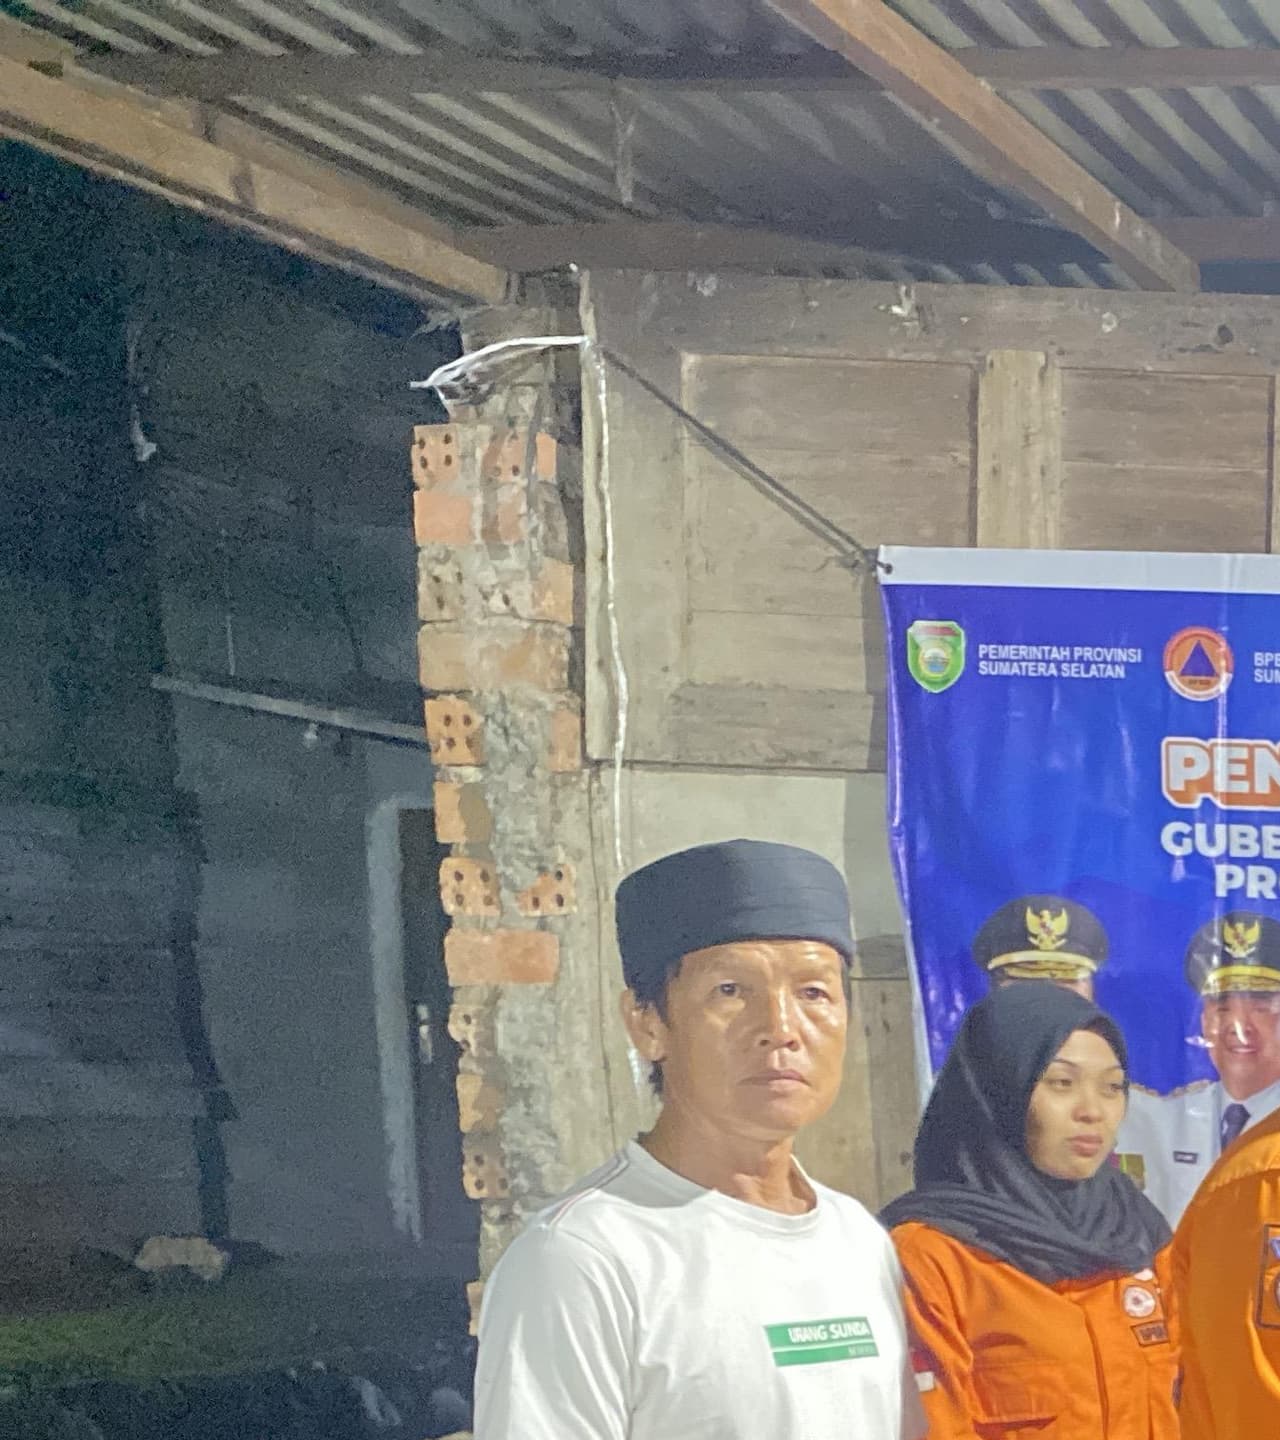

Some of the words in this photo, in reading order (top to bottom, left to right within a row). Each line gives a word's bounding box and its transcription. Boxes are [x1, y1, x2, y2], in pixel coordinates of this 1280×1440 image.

[979, 644, 1071, 661] PEMERINTAH
[1073, 648, 1143, 663] PROVINSI
[978, 660, 1057, 677] SUMATERA
[1060, 663, 1126, 679] SELATAN
